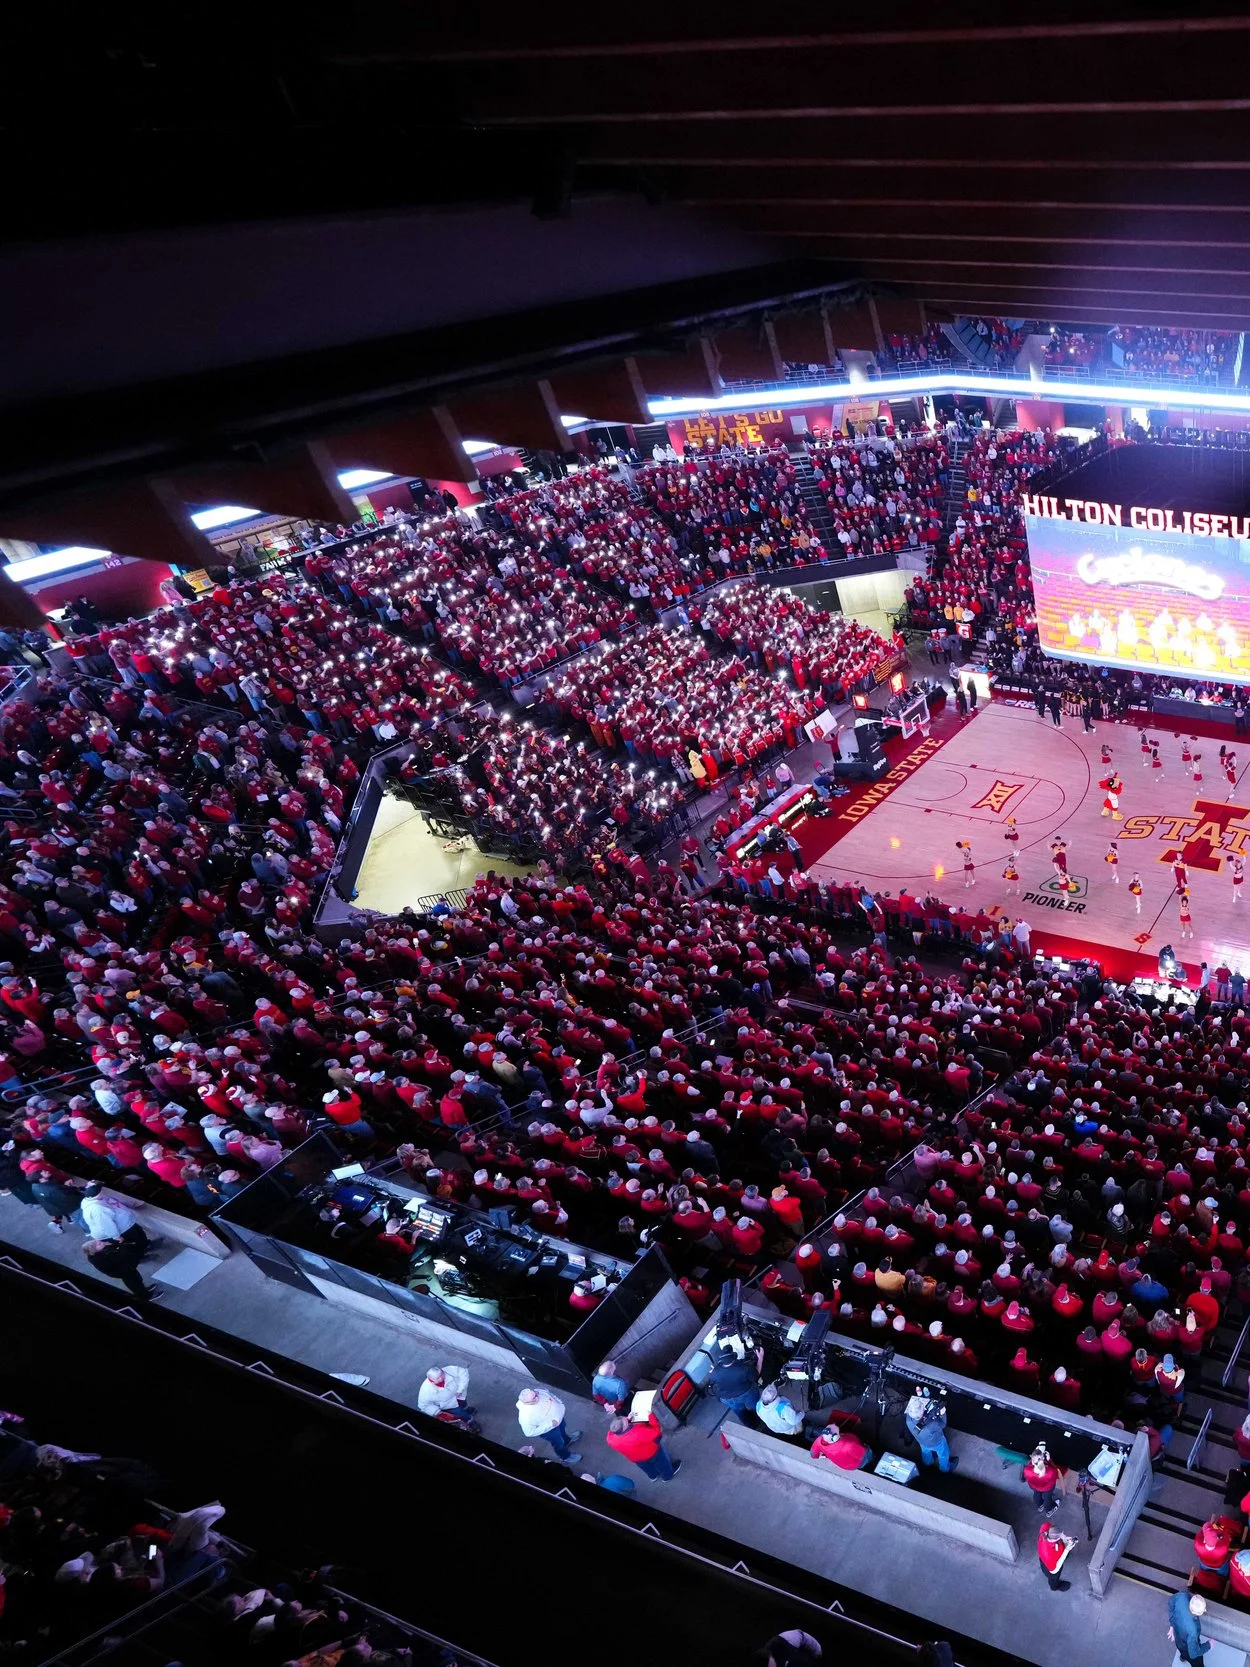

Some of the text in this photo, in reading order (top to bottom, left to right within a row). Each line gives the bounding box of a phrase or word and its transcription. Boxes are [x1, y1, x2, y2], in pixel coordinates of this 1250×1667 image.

[755, 410, 784, 425] GO
[686, 425, 763, 448] STATE
[1022, 493, 1122, 527] HILTON
[105, 557, 122, 569] 142
[838, 781, 896, 822] IOWA
[886, 738, 944, 781] STATE
[1022, 892, 1086, 914] PIONEER
